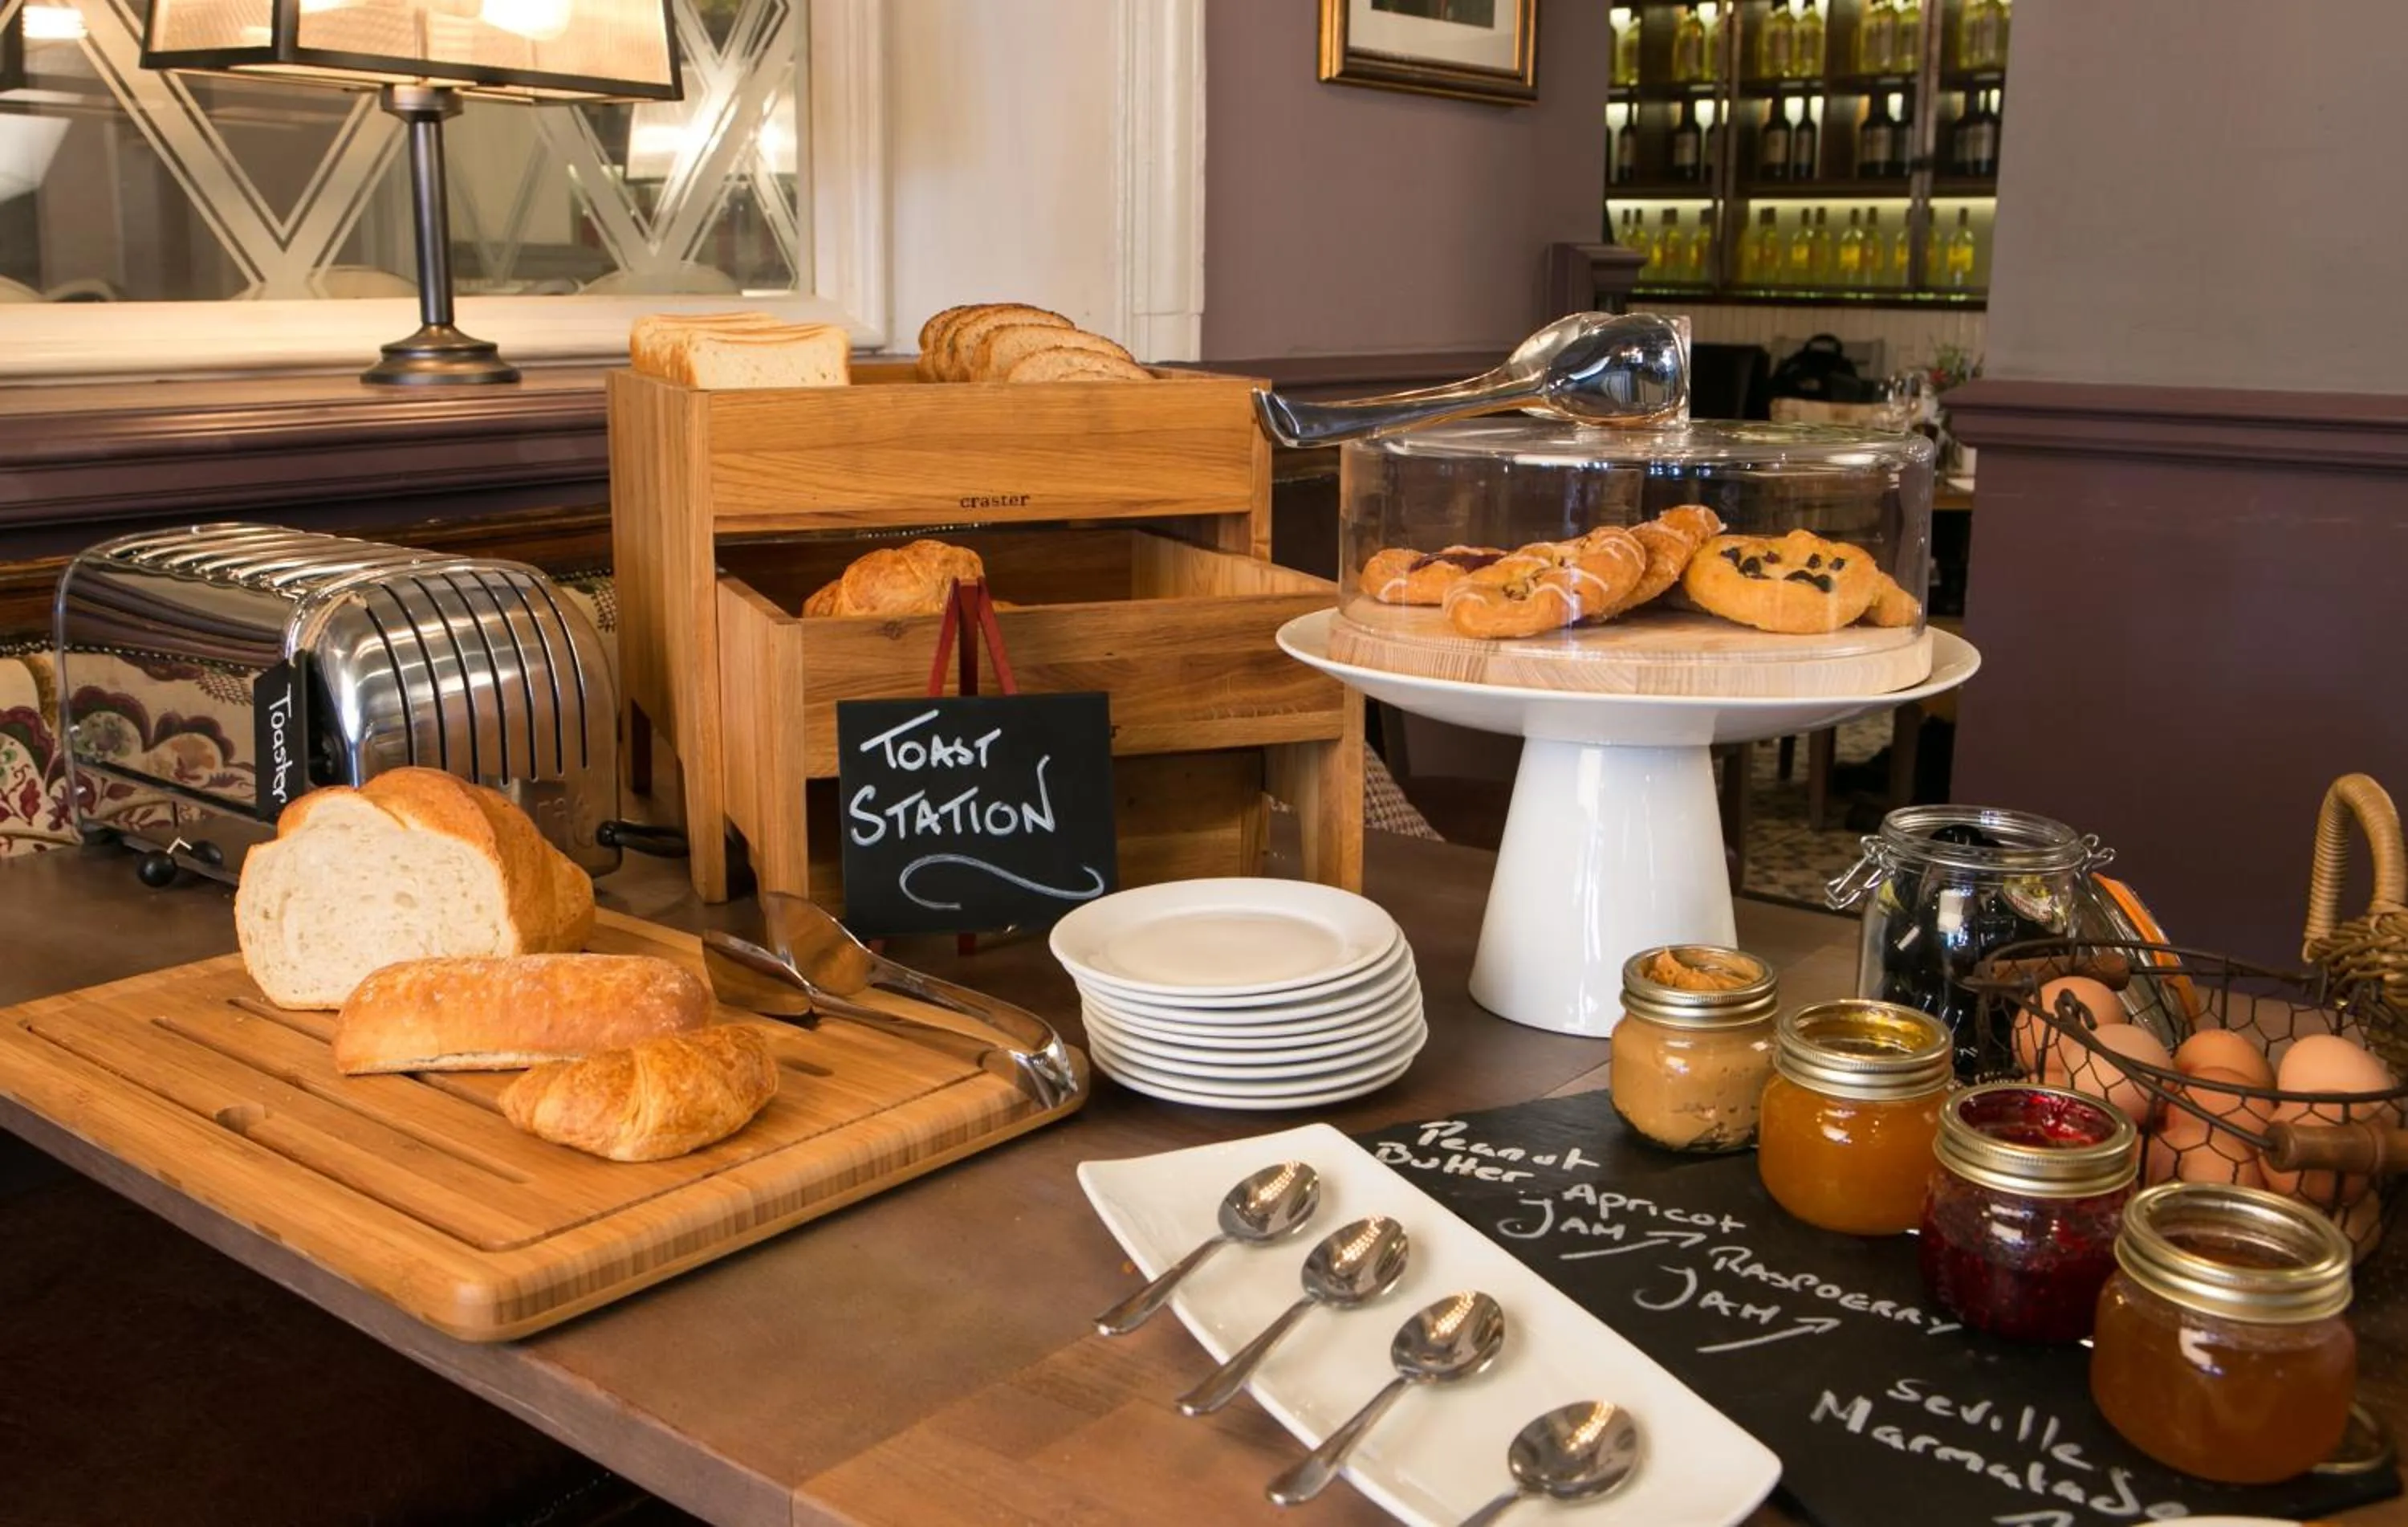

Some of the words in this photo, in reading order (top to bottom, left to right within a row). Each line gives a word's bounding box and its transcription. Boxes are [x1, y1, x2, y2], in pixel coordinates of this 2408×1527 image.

[959, 495, 1031, 508] craster
[269, 682, 293, 804] Toaster
[860, 709, 1002, 771] TOAST
[849, 755, 1056, 846] STATION
[1375, 1141, 1535, 1183] Butter
[1417, 1120, 1601, 1171] Peanut
[1496, 1198, 1626, 1241] JAM
[1562, 1183, 1747, 1234] Apricot
[1633, 1264, 1781, 1325] JAM
[1886, 1378, 2093, 1470] Seville
